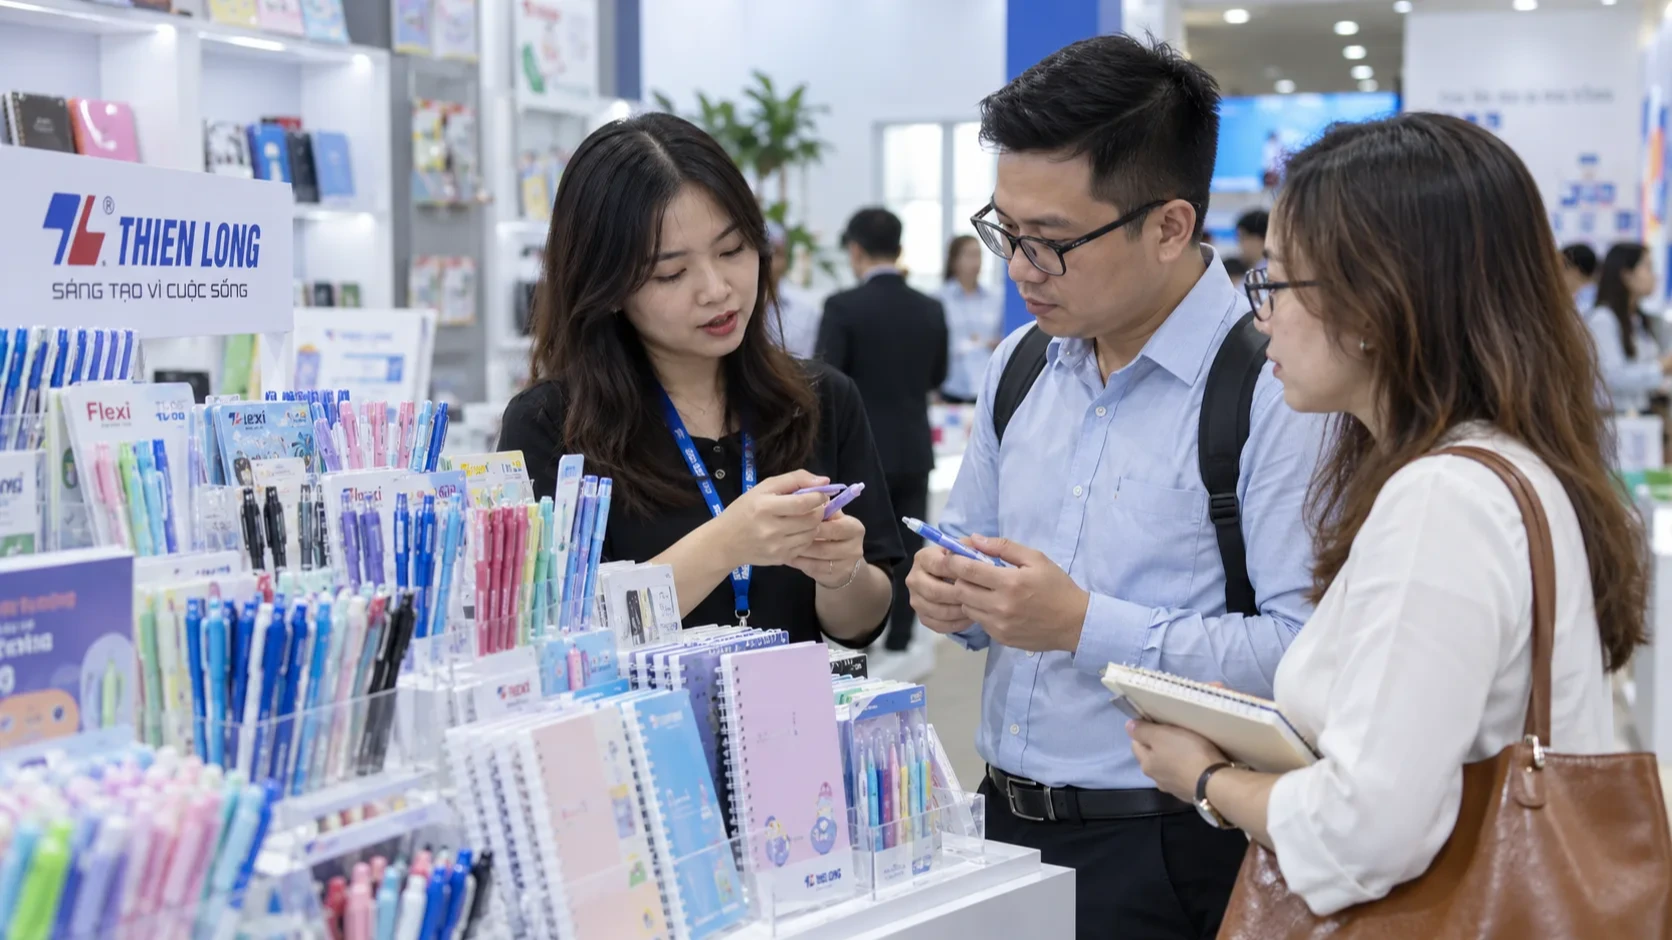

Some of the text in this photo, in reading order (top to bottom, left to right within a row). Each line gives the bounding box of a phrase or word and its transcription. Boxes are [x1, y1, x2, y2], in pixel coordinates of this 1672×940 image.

[118, 216, 261, 268] THIEN LONG
[52, 278, 248, 302] SÁNG TẠO VÌ CUỘC SỐNG
[86, 401, 131, 421] Flexi
